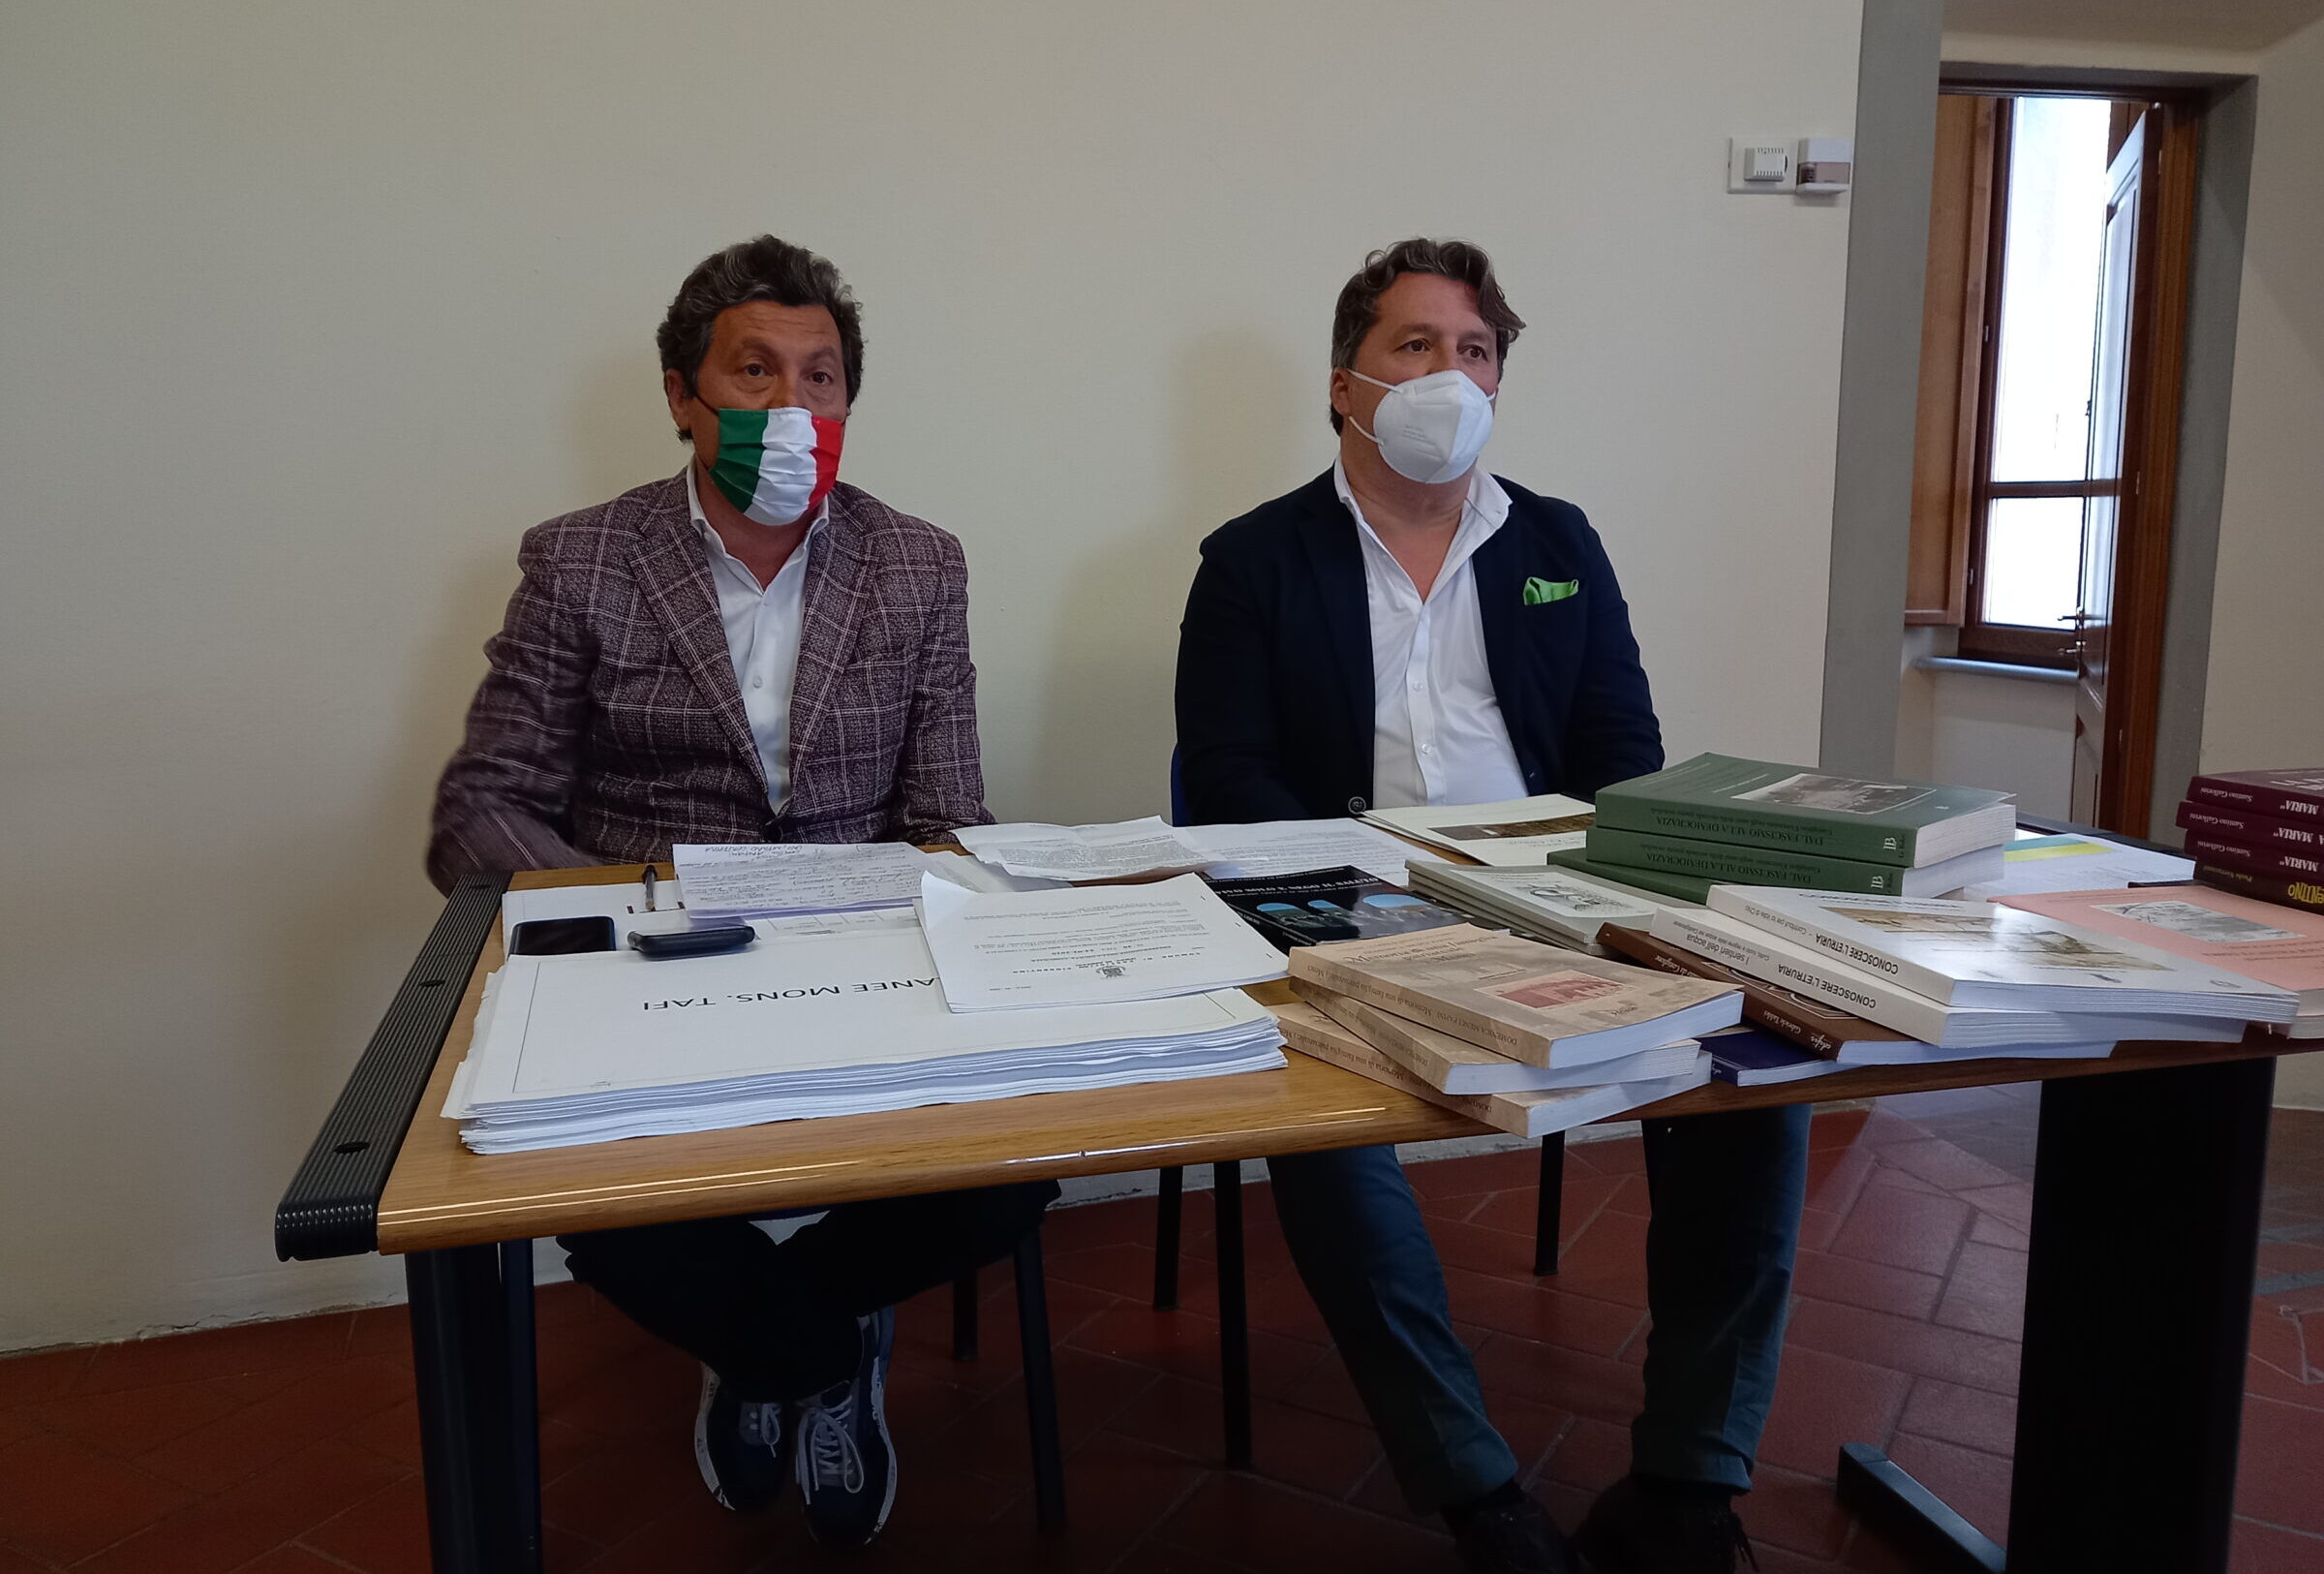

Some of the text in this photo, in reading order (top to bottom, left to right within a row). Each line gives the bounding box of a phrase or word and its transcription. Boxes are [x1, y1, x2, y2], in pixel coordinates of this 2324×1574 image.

[1686, 934, 1719, 955] dell'acqua
[1720, 947, 1745, 963] sentieri
[1816, 934, 1899, 974] CONOSCERE L'ETRURIA
[643, 978, 939, 1010] ANEE MONS. TAFI
[1778, 965, 1877, 1008] CONOSCERE L'ETRURIA
